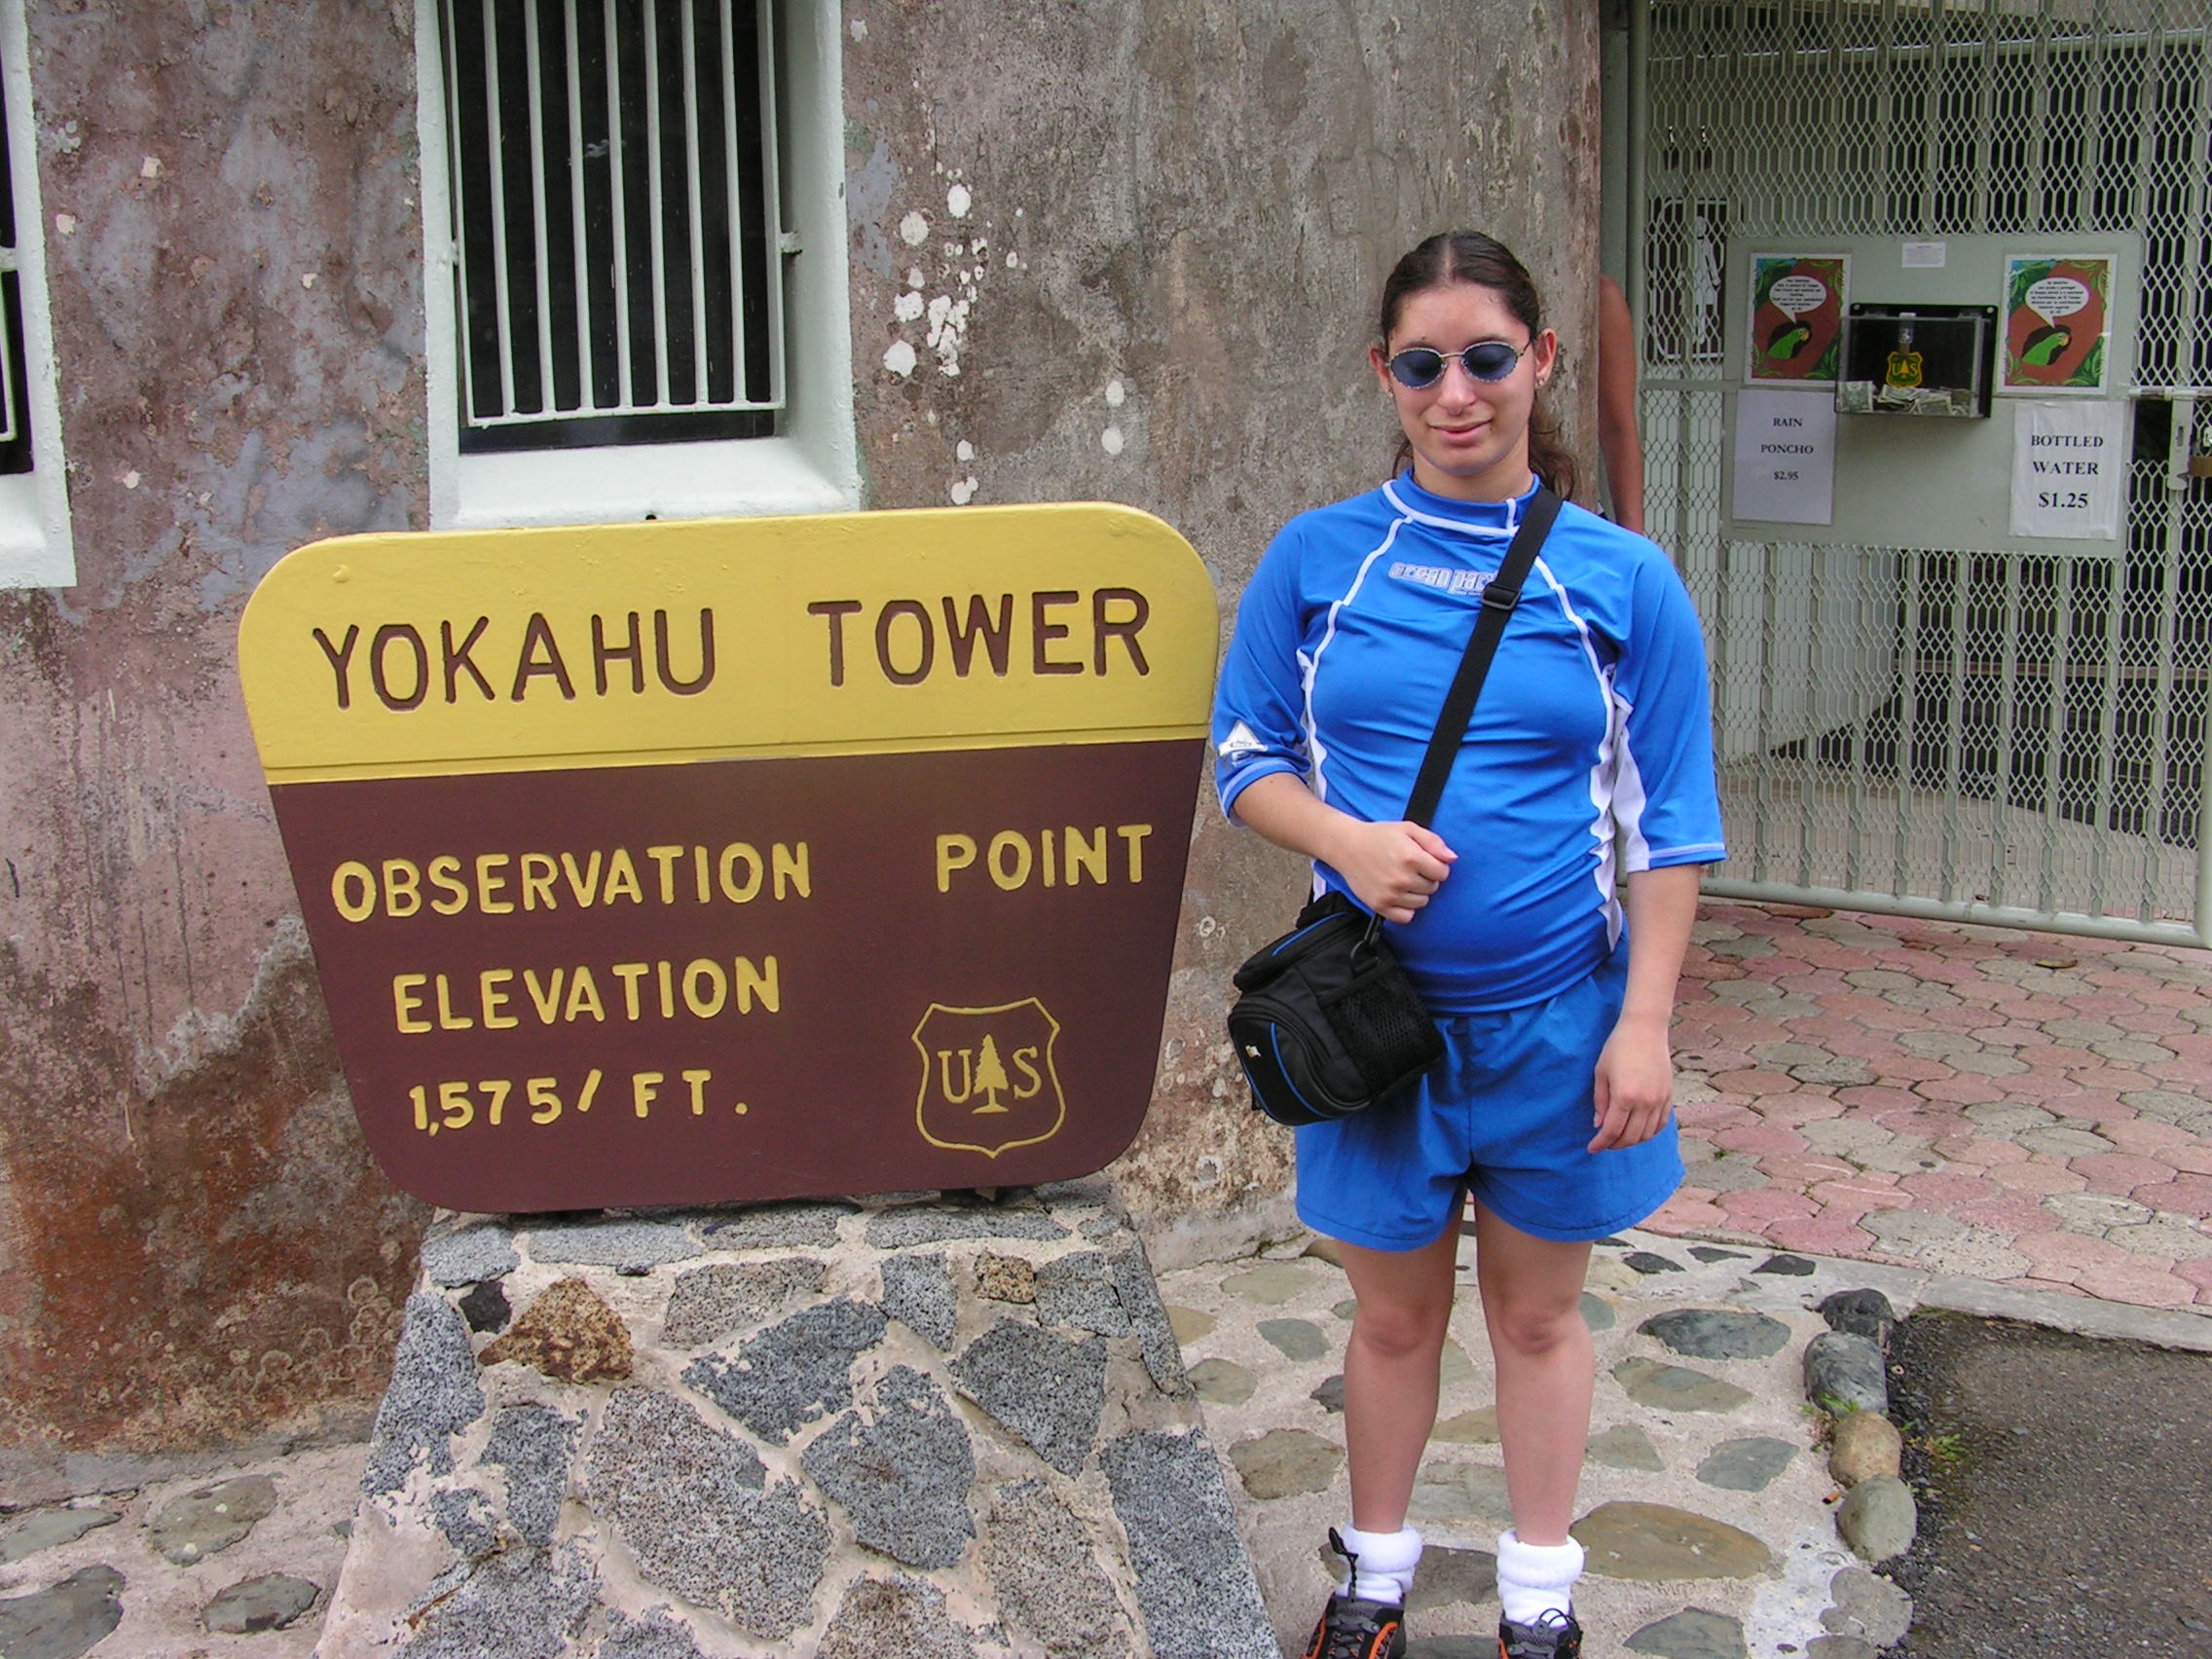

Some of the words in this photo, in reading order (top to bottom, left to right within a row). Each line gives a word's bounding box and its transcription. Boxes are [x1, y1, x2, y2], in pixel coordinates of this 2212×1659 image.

[1773, 418, 1803, 427] RAIN
[2030, 434, 2104, 448] BOTTLED
[1760, 444, 1814, 455] PONCHO
[2032, 461, 2099, 475] WATER
[1774, 470, 1799, 481] $2.95
[2038, 491, 2088, 508] $1.25
[312, 608, 716, 711] YOKAHU
[807, 587, 1150, 687] TOWER
[331, 842, 811, 923] OBSERVATION
[936, 825, 1153, 894] POINT
[393, 955, 780, 1034] ELEVATION
